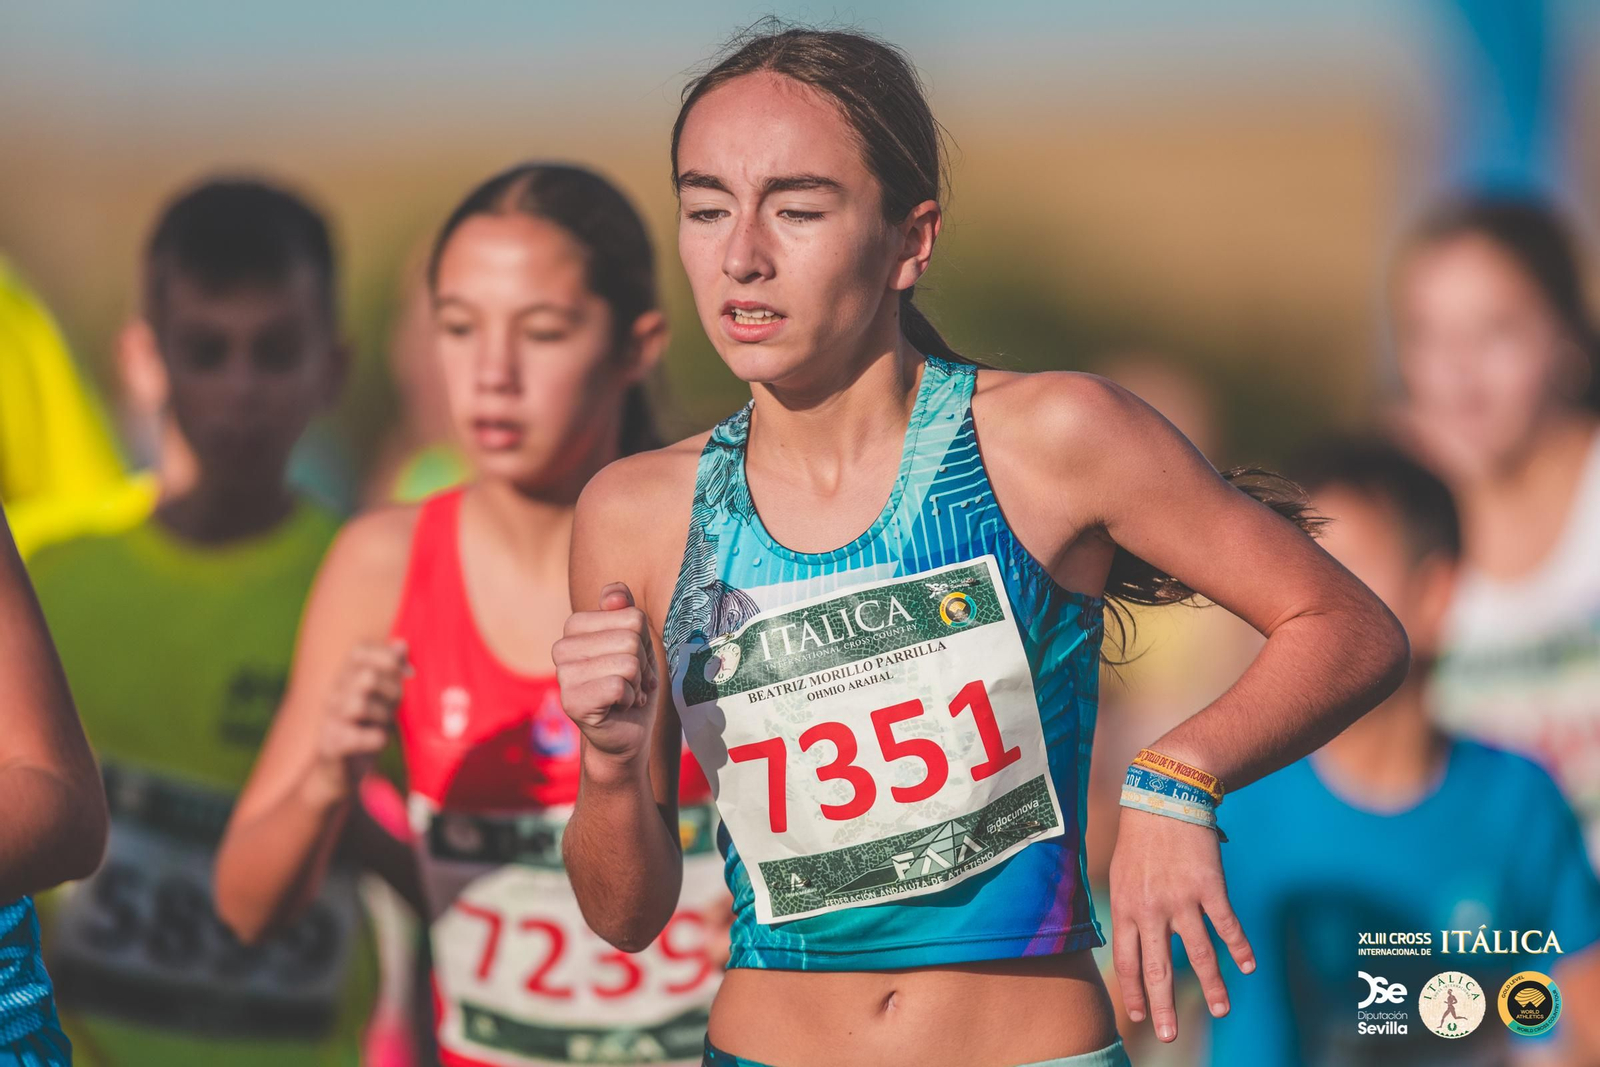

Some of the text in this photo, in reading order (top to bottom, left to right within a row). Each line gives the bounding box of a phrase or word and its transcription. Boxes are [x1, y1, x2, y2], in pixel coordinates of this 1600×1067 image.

[757, 596, 914, 661] ITÁLICA
[843, 637, 871, 650] CROSS
[873, 623, 918, 641] COUNTRY
[748, 641, 947, 704] BEATRIZ MORILLO PARRILLA
[807, 671, 894, 701] OHMIO ARAHAL
[727, 680, 1022, 834] 7351
[825, 890, 877, 907] FEDERACIÓN
[880, 881, 929, 898] ANDALUZA
[931, 875, 944, 886] DE
[948, 851, 994, 880] ATLETISMO
